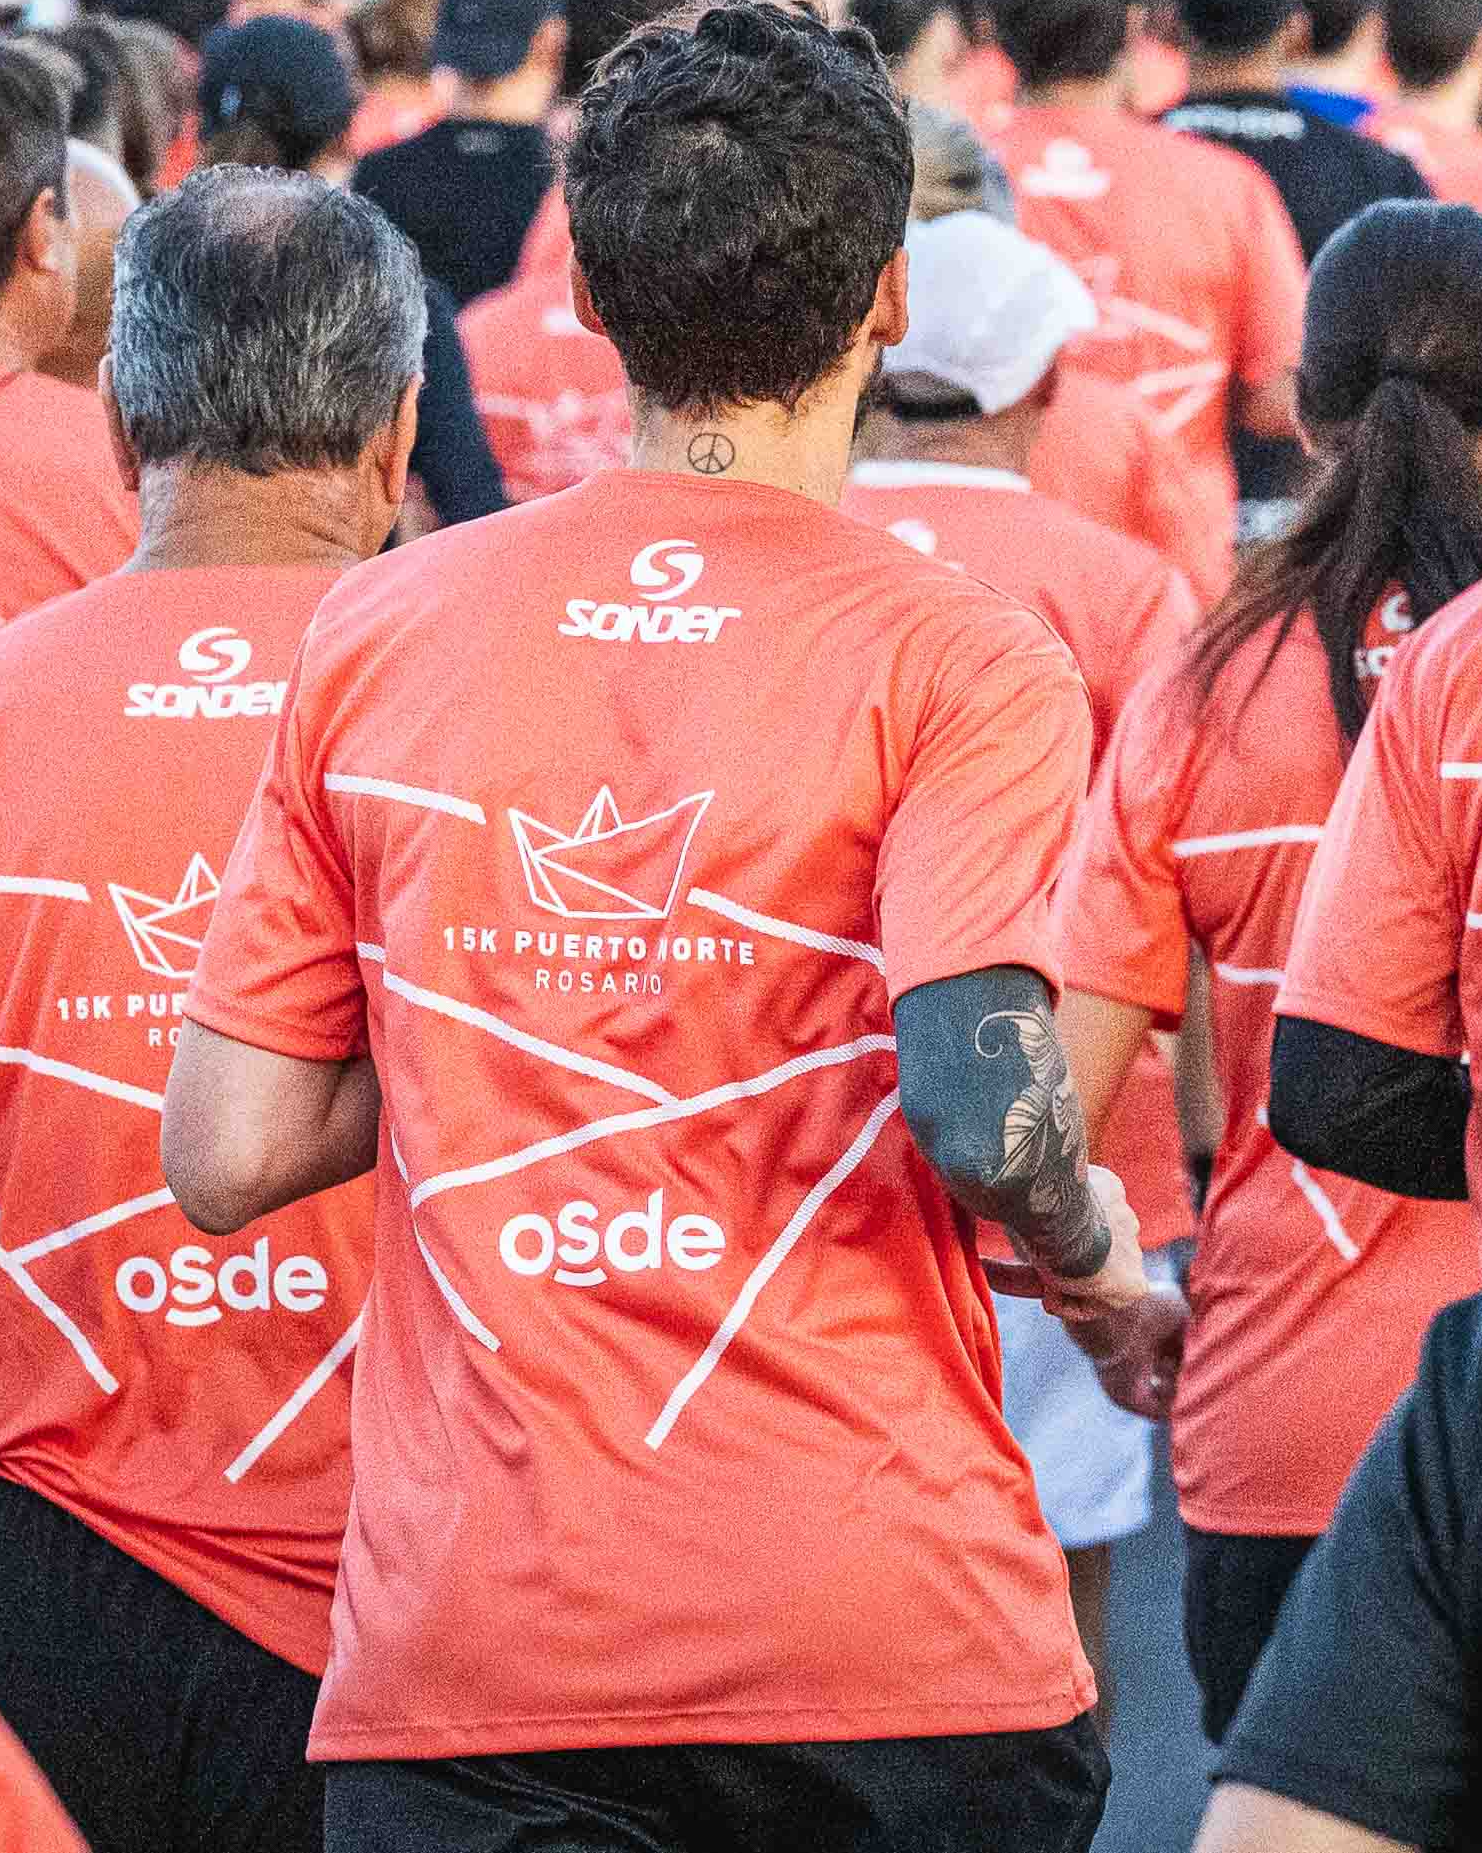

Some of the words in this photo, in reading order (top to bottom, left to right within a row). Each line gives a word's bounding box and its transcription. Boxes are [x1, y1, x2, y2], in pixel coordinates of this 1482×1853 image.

[443, 926, 497, 954] 15K
[514, 930, 647, 961] PUERTO
[534, 968, 663, 996] ROSARIO
[57, 995, 112, 1022] 15K
[498, 1187, 727, 1276] osde
[115, 1236, 328, 1314] osde
